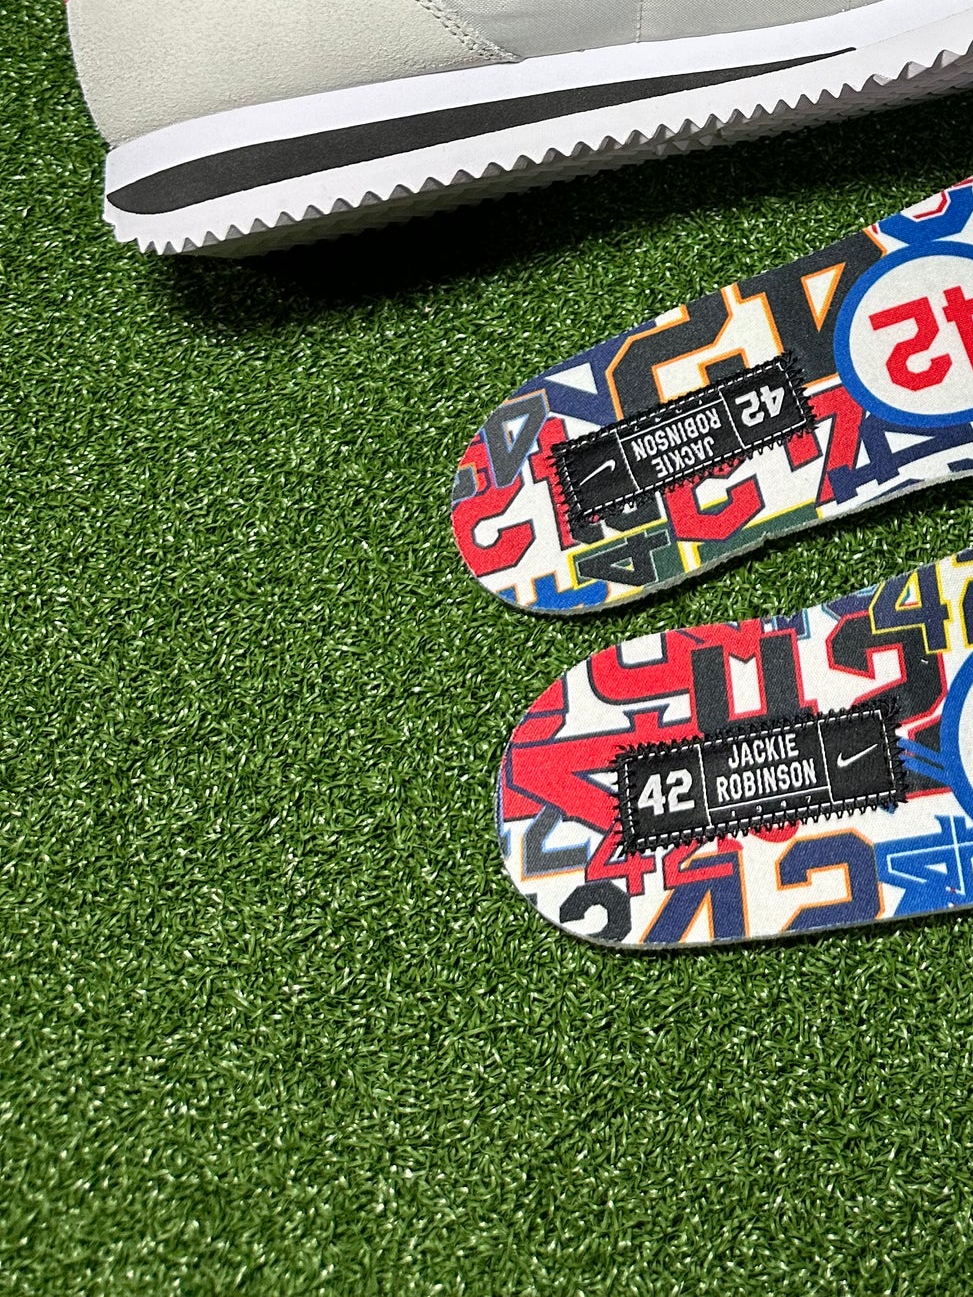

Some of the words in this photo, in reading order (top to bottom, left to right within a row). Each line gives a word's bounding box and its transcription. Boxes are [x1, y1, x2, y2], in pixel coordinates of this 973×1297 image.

[735, 385, 785, 427] 42
[631, 407, 722, 462] ROBINSON
[651, 435, 715, 479] JACKIE
[728, 733, 800, 769] JACKIE
[637, 768, 695, 816] 42
[716, 758, 817, 803] ROBINSON
